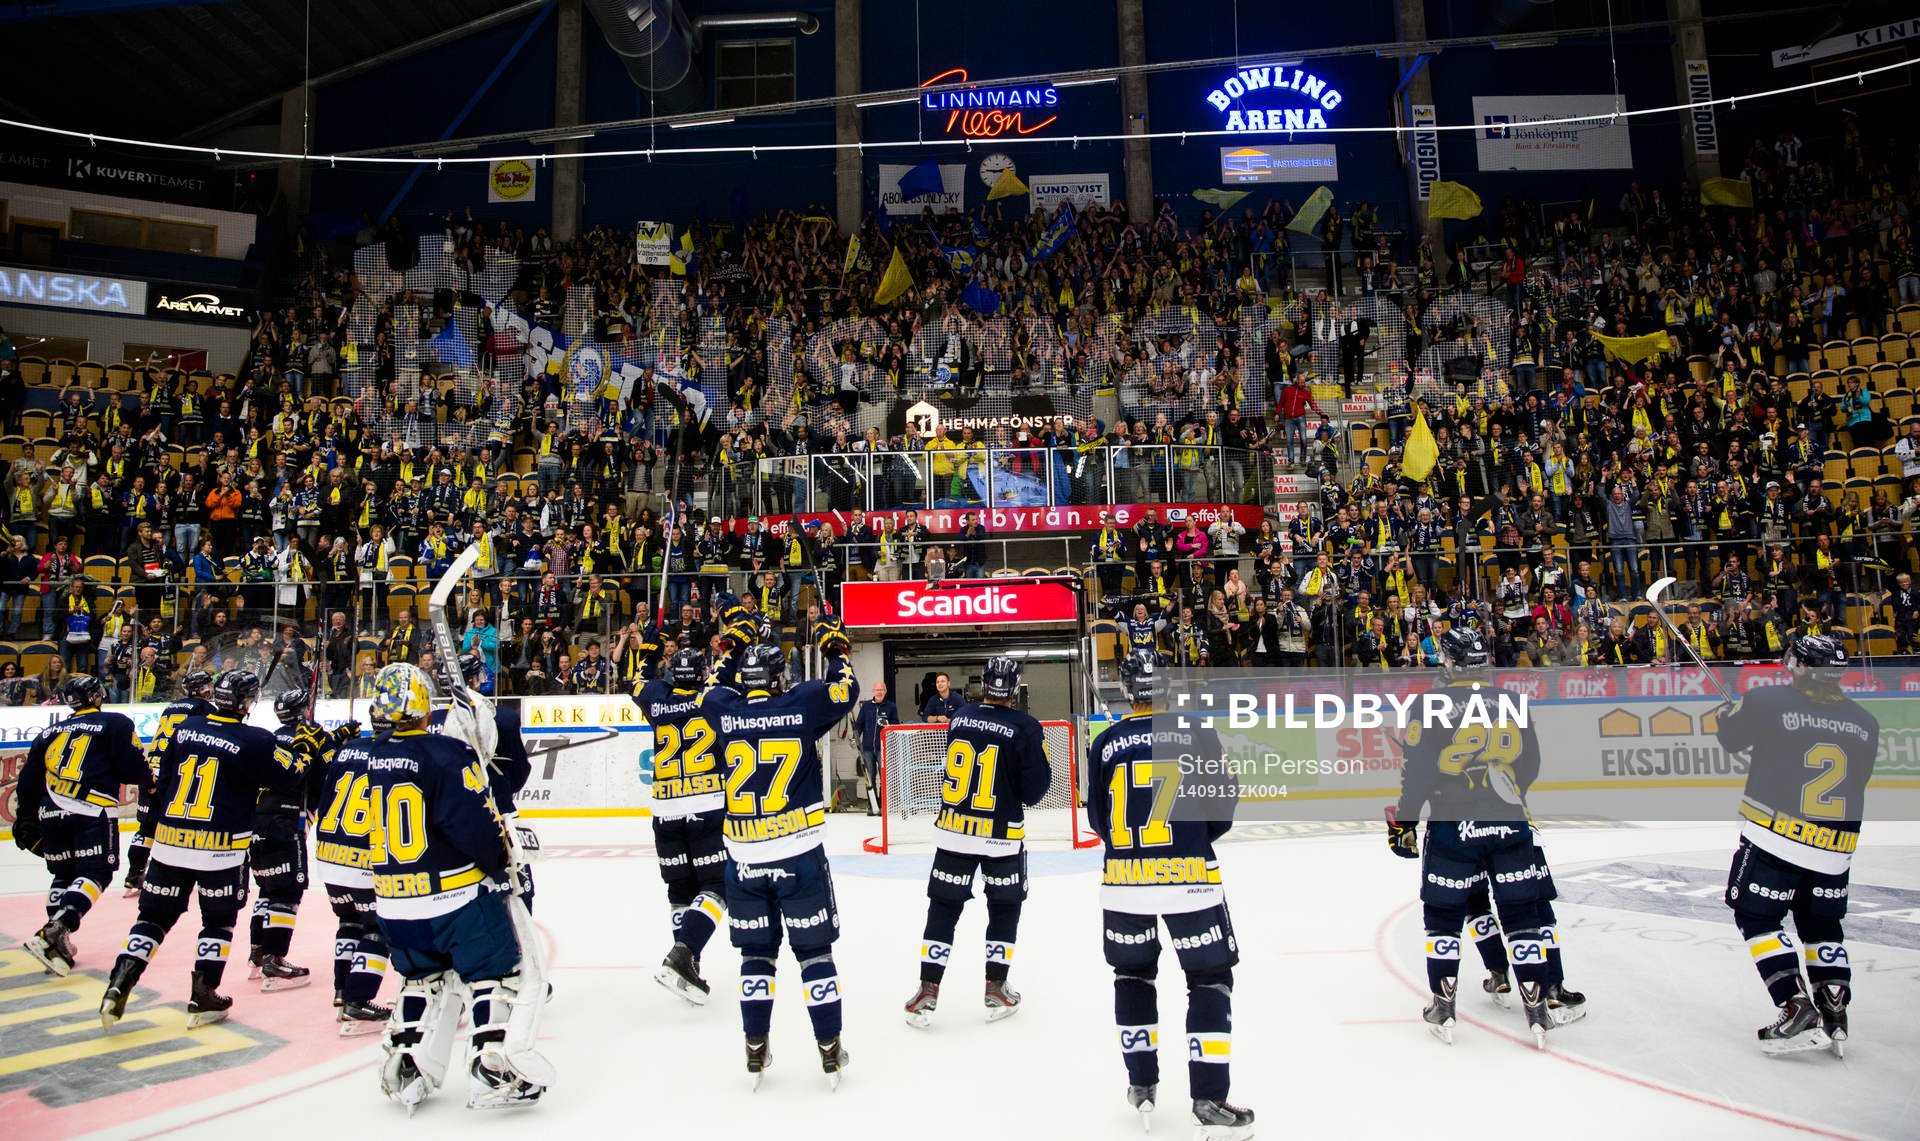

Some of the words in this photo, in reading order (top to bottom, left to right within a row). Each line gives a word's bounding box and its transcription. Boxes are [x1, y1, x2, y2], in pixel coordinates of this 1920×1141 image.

[926, 88, 1058, 108] LINNMANS
[1206, 66, 1342, 112] BOWLING
[1226, 108, 1327, 130] ARENA
[1514, 128, 1578, 141] Jönköping
[882, 192, 909, 204] ABO
[897, 591, 1017, 617] Scandic
[1503, 677, 1541, 695] mix
[1565, 675, 1609, 695] mix
[1640, 669, 1706, 696] mix
[53, 722, 103, 733] Husqvarna
[732, 714, 803, 730] Husqvarna
[958, 716, 1014, 738] Husqvarna
[1800, 713, 1869, 741] Husqvarna
[186, 731, 241, 754] Husqvarna
[655, 716, 717, 781] 22
[1112, 730, 1192, 752] Husqvarna
[45, 731, 92, 782] 41
[368, 756, 419, 773] Husqvarna
[725, 738, 803, 816] 27
[942, 738, 999, 812] 91
[1800, 742, 1848, 821] 2
[46, 773, 82, 798] POLI
[165, 754, 219, 822] 11
[320, 771, 370, 837] 16
[1109, 758, 1184, 849] 17
[370, 782, 429, 865] 40
[724, 807, 808, 842] LLIAMSSON
[937, 808, 994, 839] JÄMTIN
[1458, 820, 1519, 841] Kinnarps
[316, 841, 374, 869] ANDBER
[693, 850, 728, 866] essell
[737, 862, 796, 881] Kinnarps
[932, 868, 971, 885] essell
[982, 873, 1020, 886] essell
[1104, 857, 1207, 884] JOHANSSON
[1428, 872, 1472, 889] essell
[1496, 864, 1536, 883] essell
[143, 881, 180, 897] essell
[1749, 882, 1796, 901] essell
[1812, 884, 1848, 897] esse
[728, 916, 769, 930] essell
[786, 908, 828, 928] essell
[1475, 916, 1499, 936] GA
[1106, 926, 1156, 944] essell
[1172, 925, 1223, 950] essell
[126, 937, 154, 958] GA
[197, 942, 221, 957] GA
[1434, 940, 1460, 956] GA
[1513, 944, 1541, 961] GA
[1818, 945, 1849, 964] GA
[742, 979, 769, 997] GA
[810, 980, 839, 1001] GA
[1121, 1029, 1151, 1049] GA
